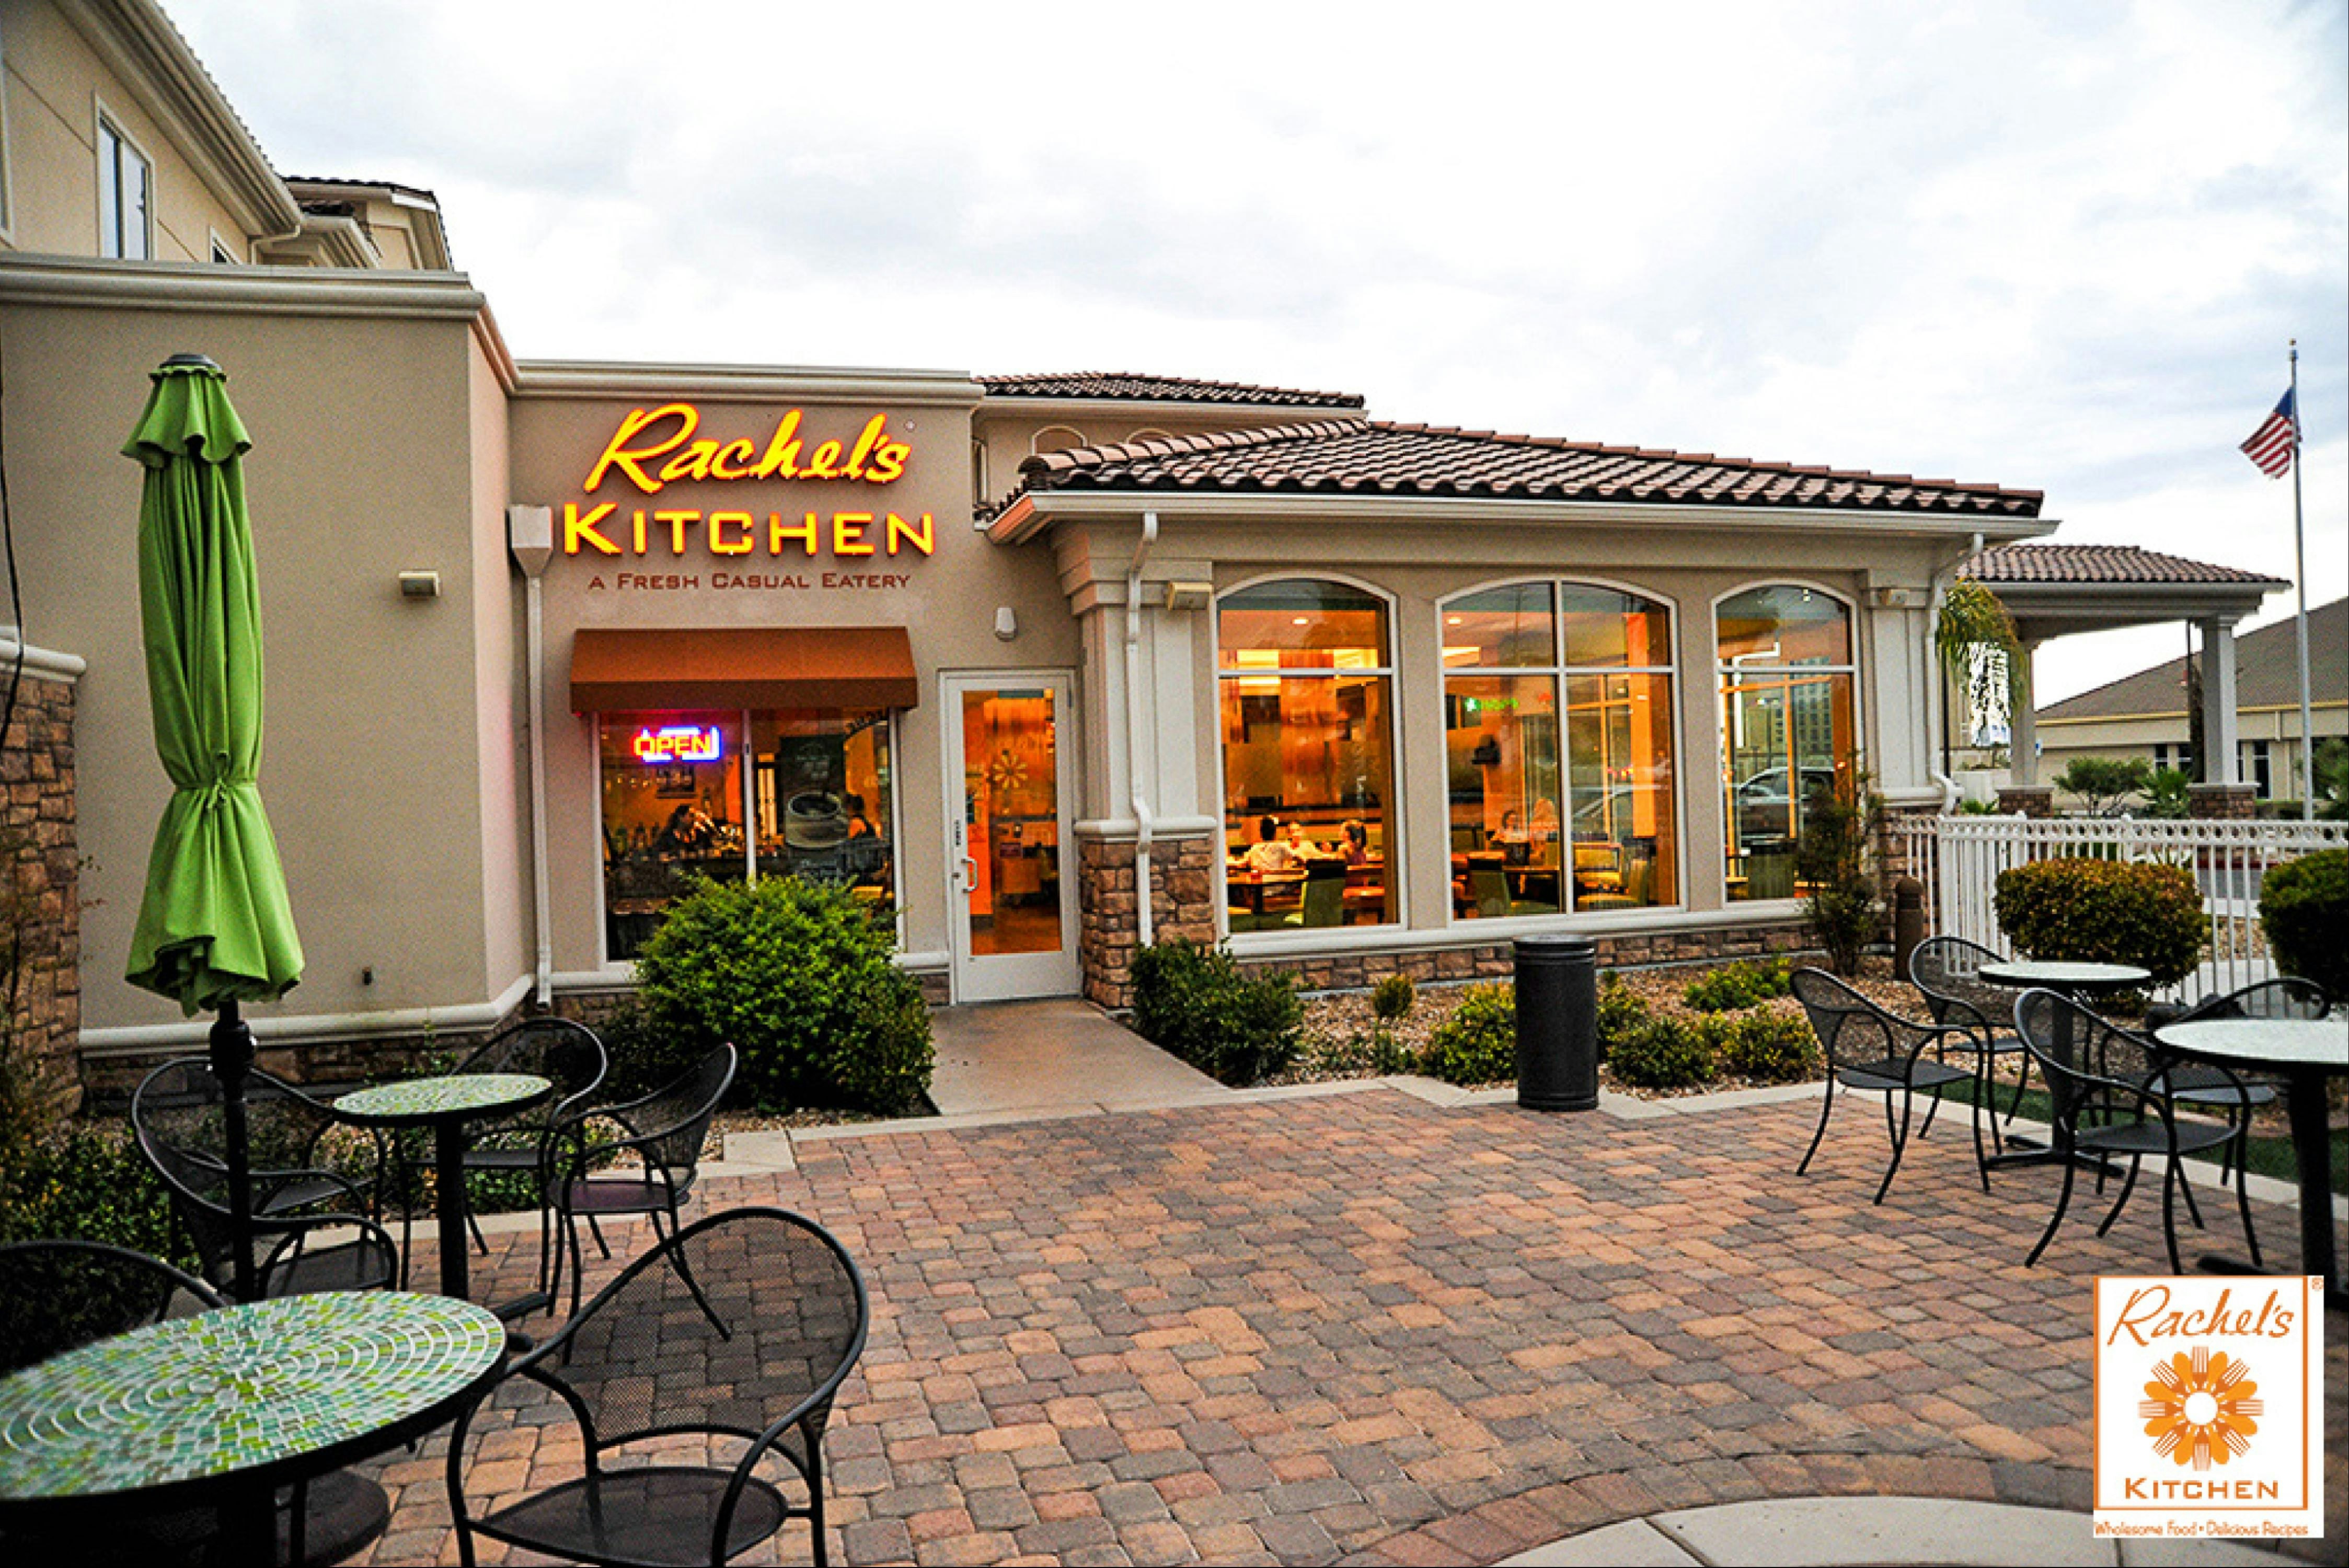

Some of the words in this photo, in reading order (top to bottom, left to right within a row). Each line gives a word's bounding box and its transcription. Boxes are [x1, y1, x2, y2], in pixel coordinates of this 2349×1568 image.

[583, 402, 911, 493] Rachel's
[563, 502, 935, 556] KITCHEN
[617, 572, 699, 590] FRESH
[711, 572, 810, 590] CASUAL
[822, 572, 911, 589] EATERY
[633, 735, 710, 756] OPEN
